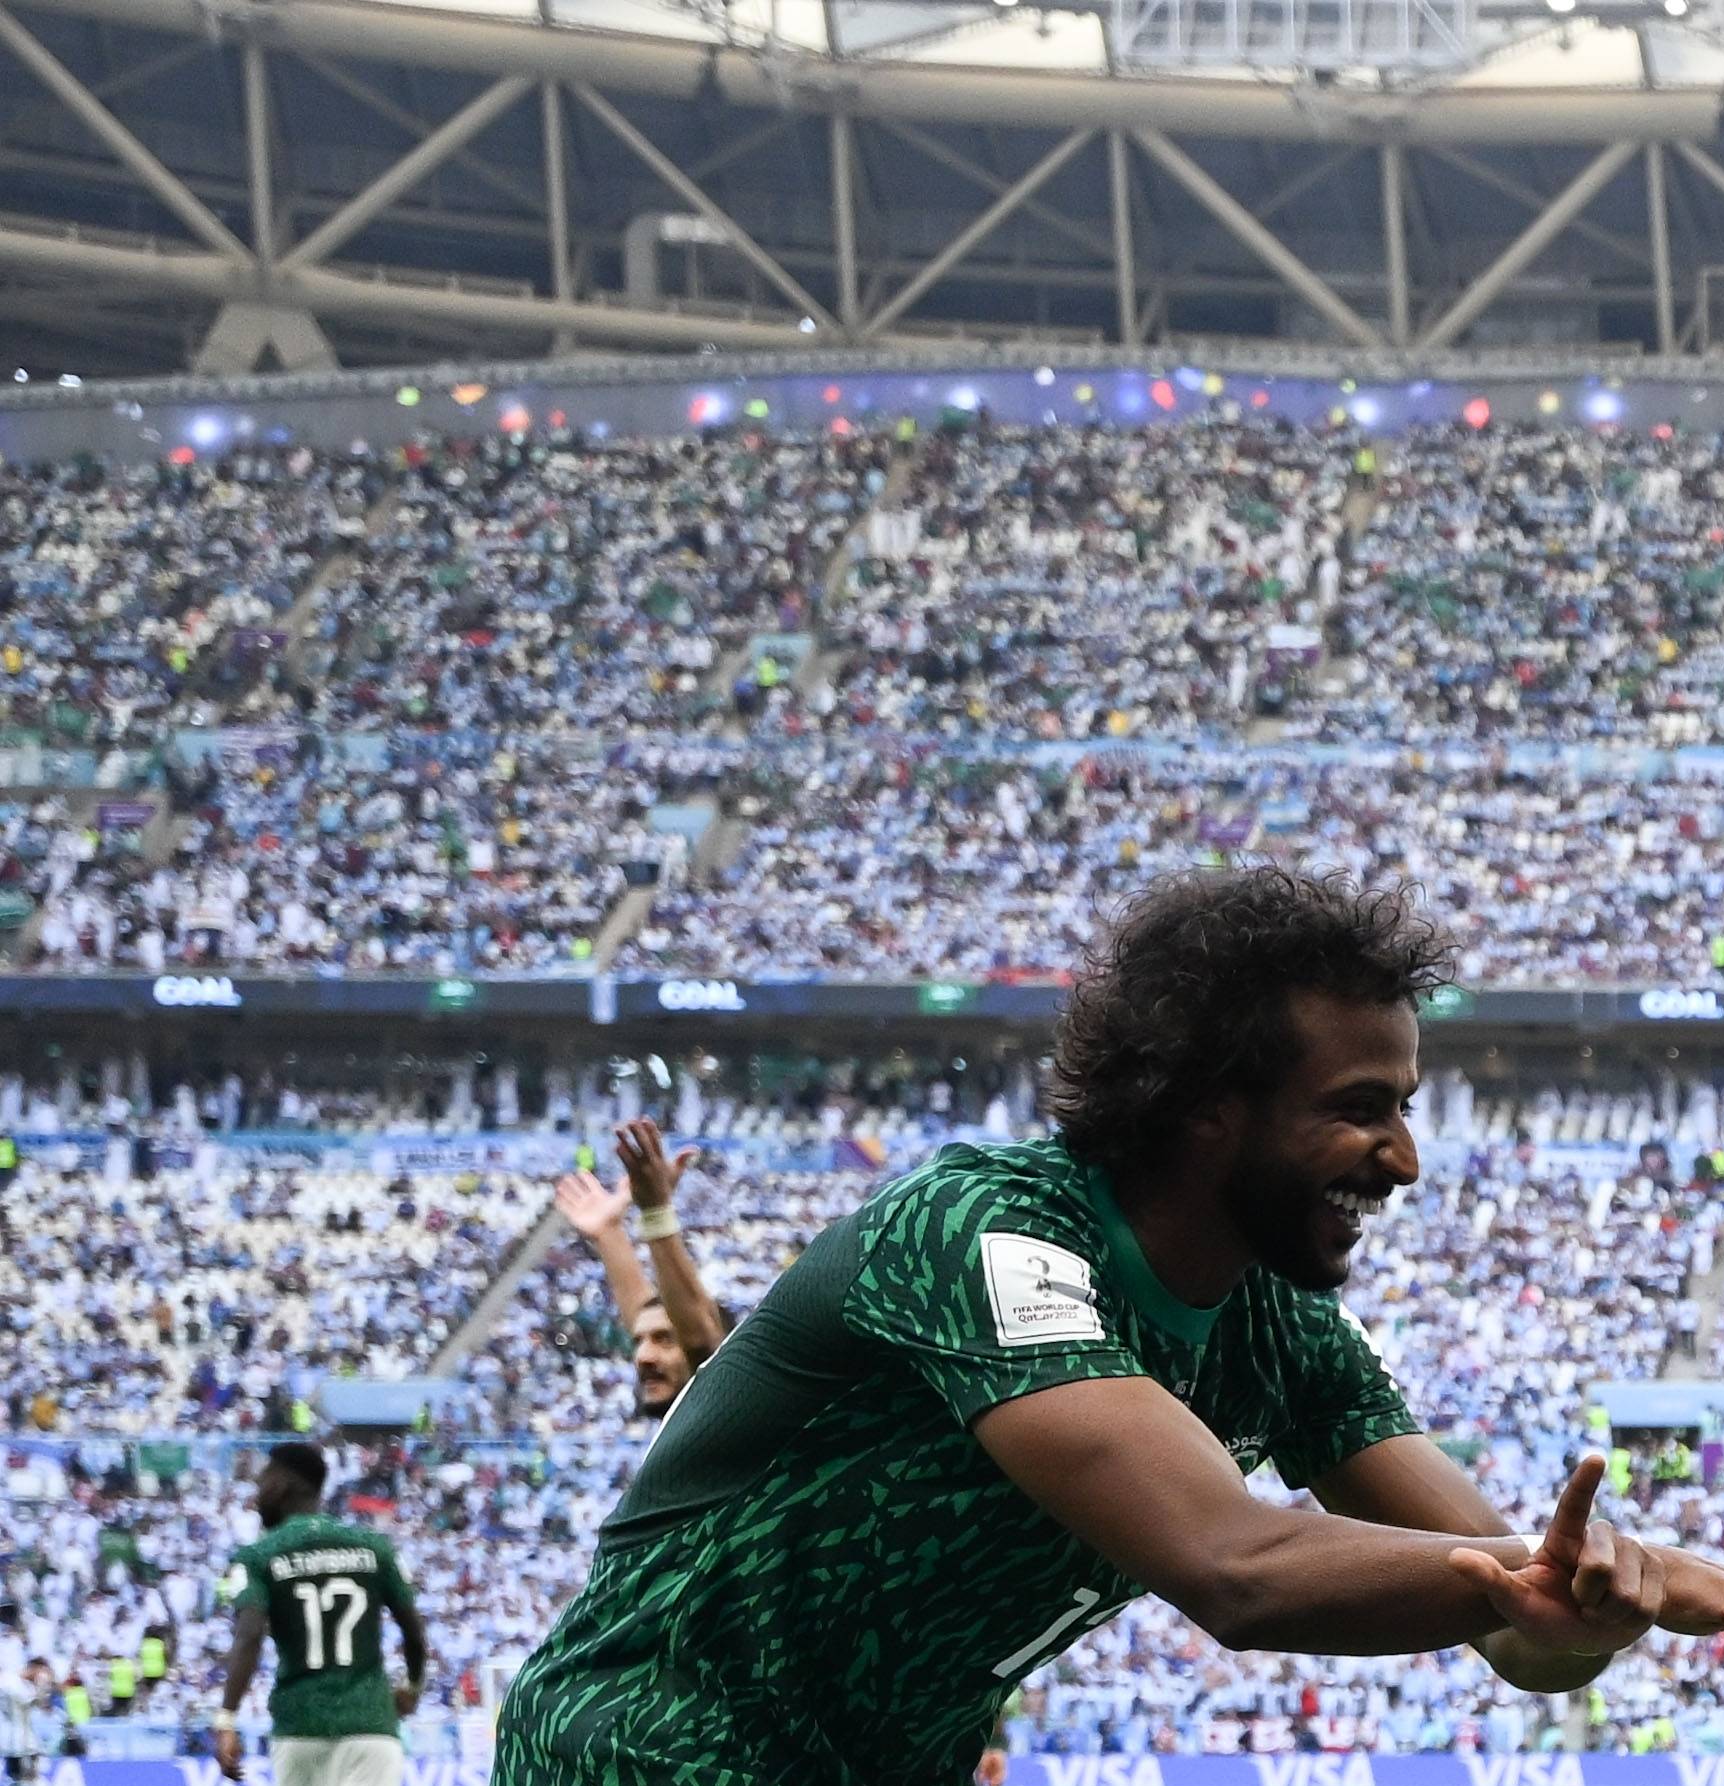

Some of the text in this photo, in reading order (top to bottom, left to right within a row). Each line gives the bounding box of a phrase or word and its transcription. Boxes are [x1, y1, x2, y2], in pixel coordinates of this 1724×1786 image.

[153, 975, 241, 1007] GOAL
[658, 980, 746, 1011] GOAL
[1640, 989, 1724, 1019] GOAL
[1013, 1305, 1032, 1315] FIFA
[1033, 1303, 1064, 1312] WORLD
[293, 1576, 368, 1670] 17
